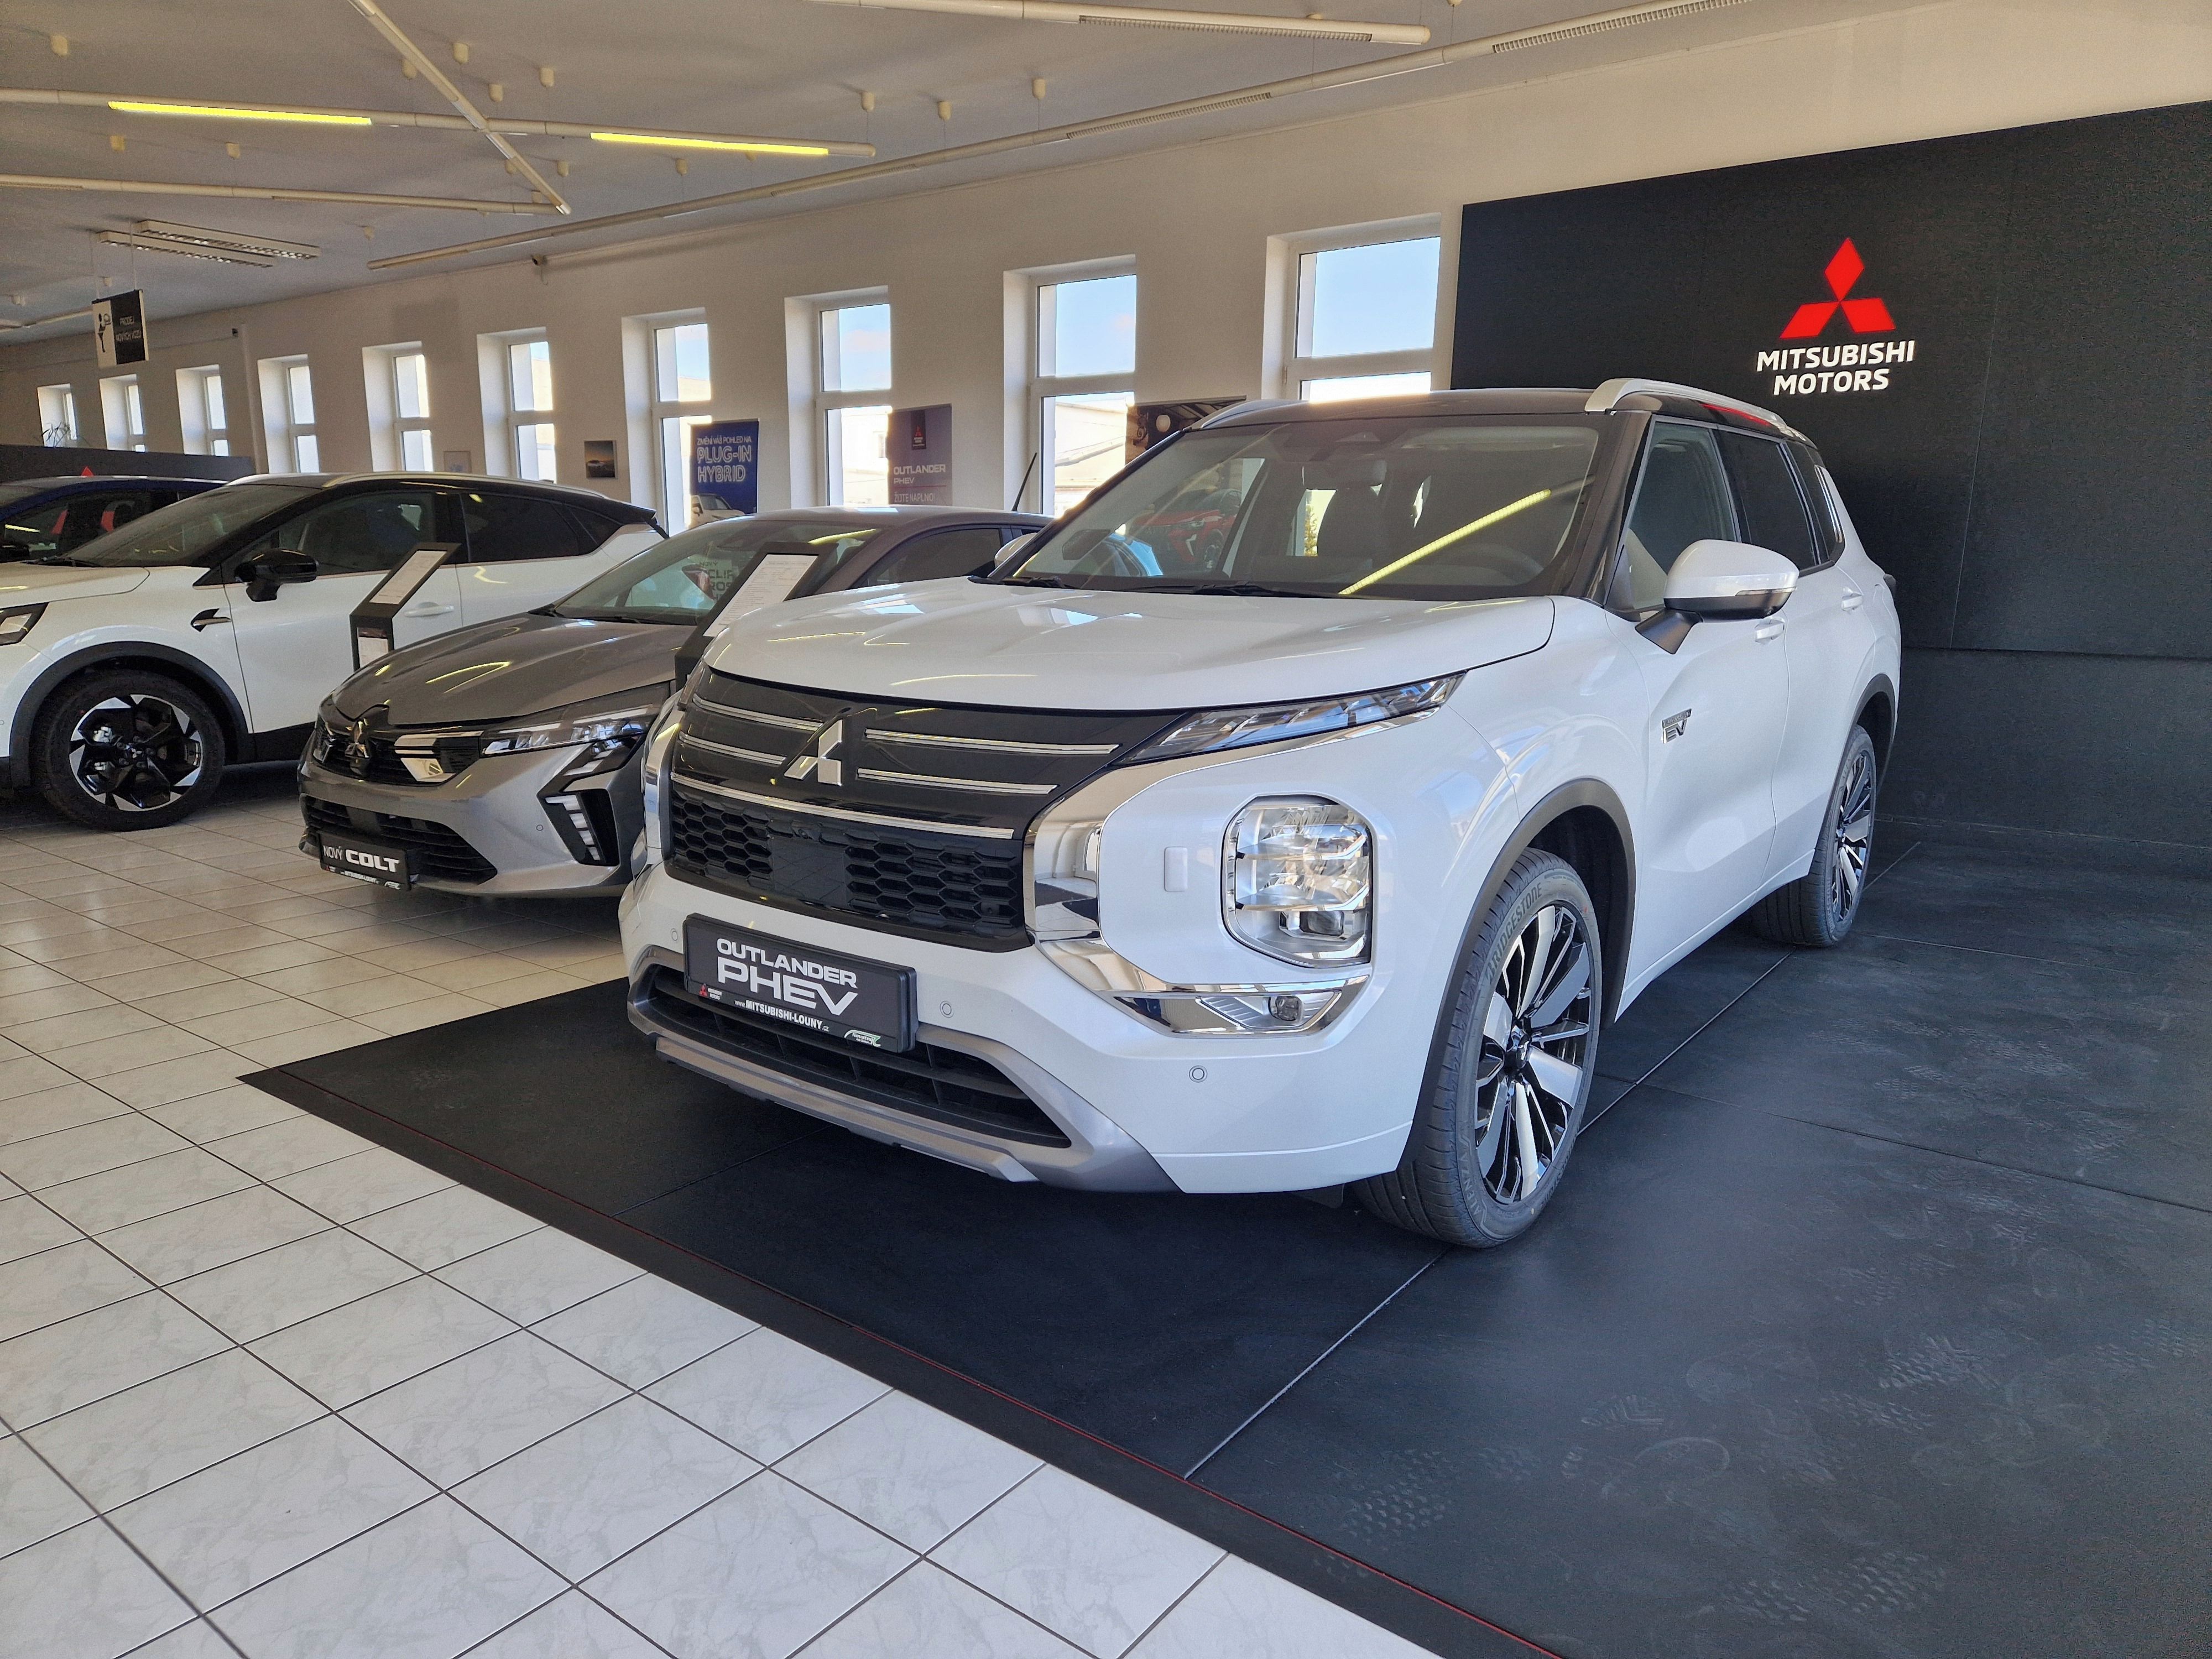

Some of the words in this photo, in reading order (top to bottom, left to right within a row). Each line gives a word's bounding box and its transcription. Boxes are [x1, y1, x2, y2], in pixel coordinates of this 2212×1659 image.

[1756, 340, 1916, 372] MITSUBISHI
[1773, 368, 1890, 395] MOTORS
[697, 445, 752, 464] PLUG-IN
[697, 465, 746, 483] HYBRID
[894, 464, 946, 475] OUTLANDER
[323, 846, 343, 860] NOVÝ
[346, 849, 399, 873] COLT
[1486, 883, 1542, 984] BRIDGESTONE
[717, 938, 858, 989] OUTLANDER
[717, 956, 858, 1016] PHEV
